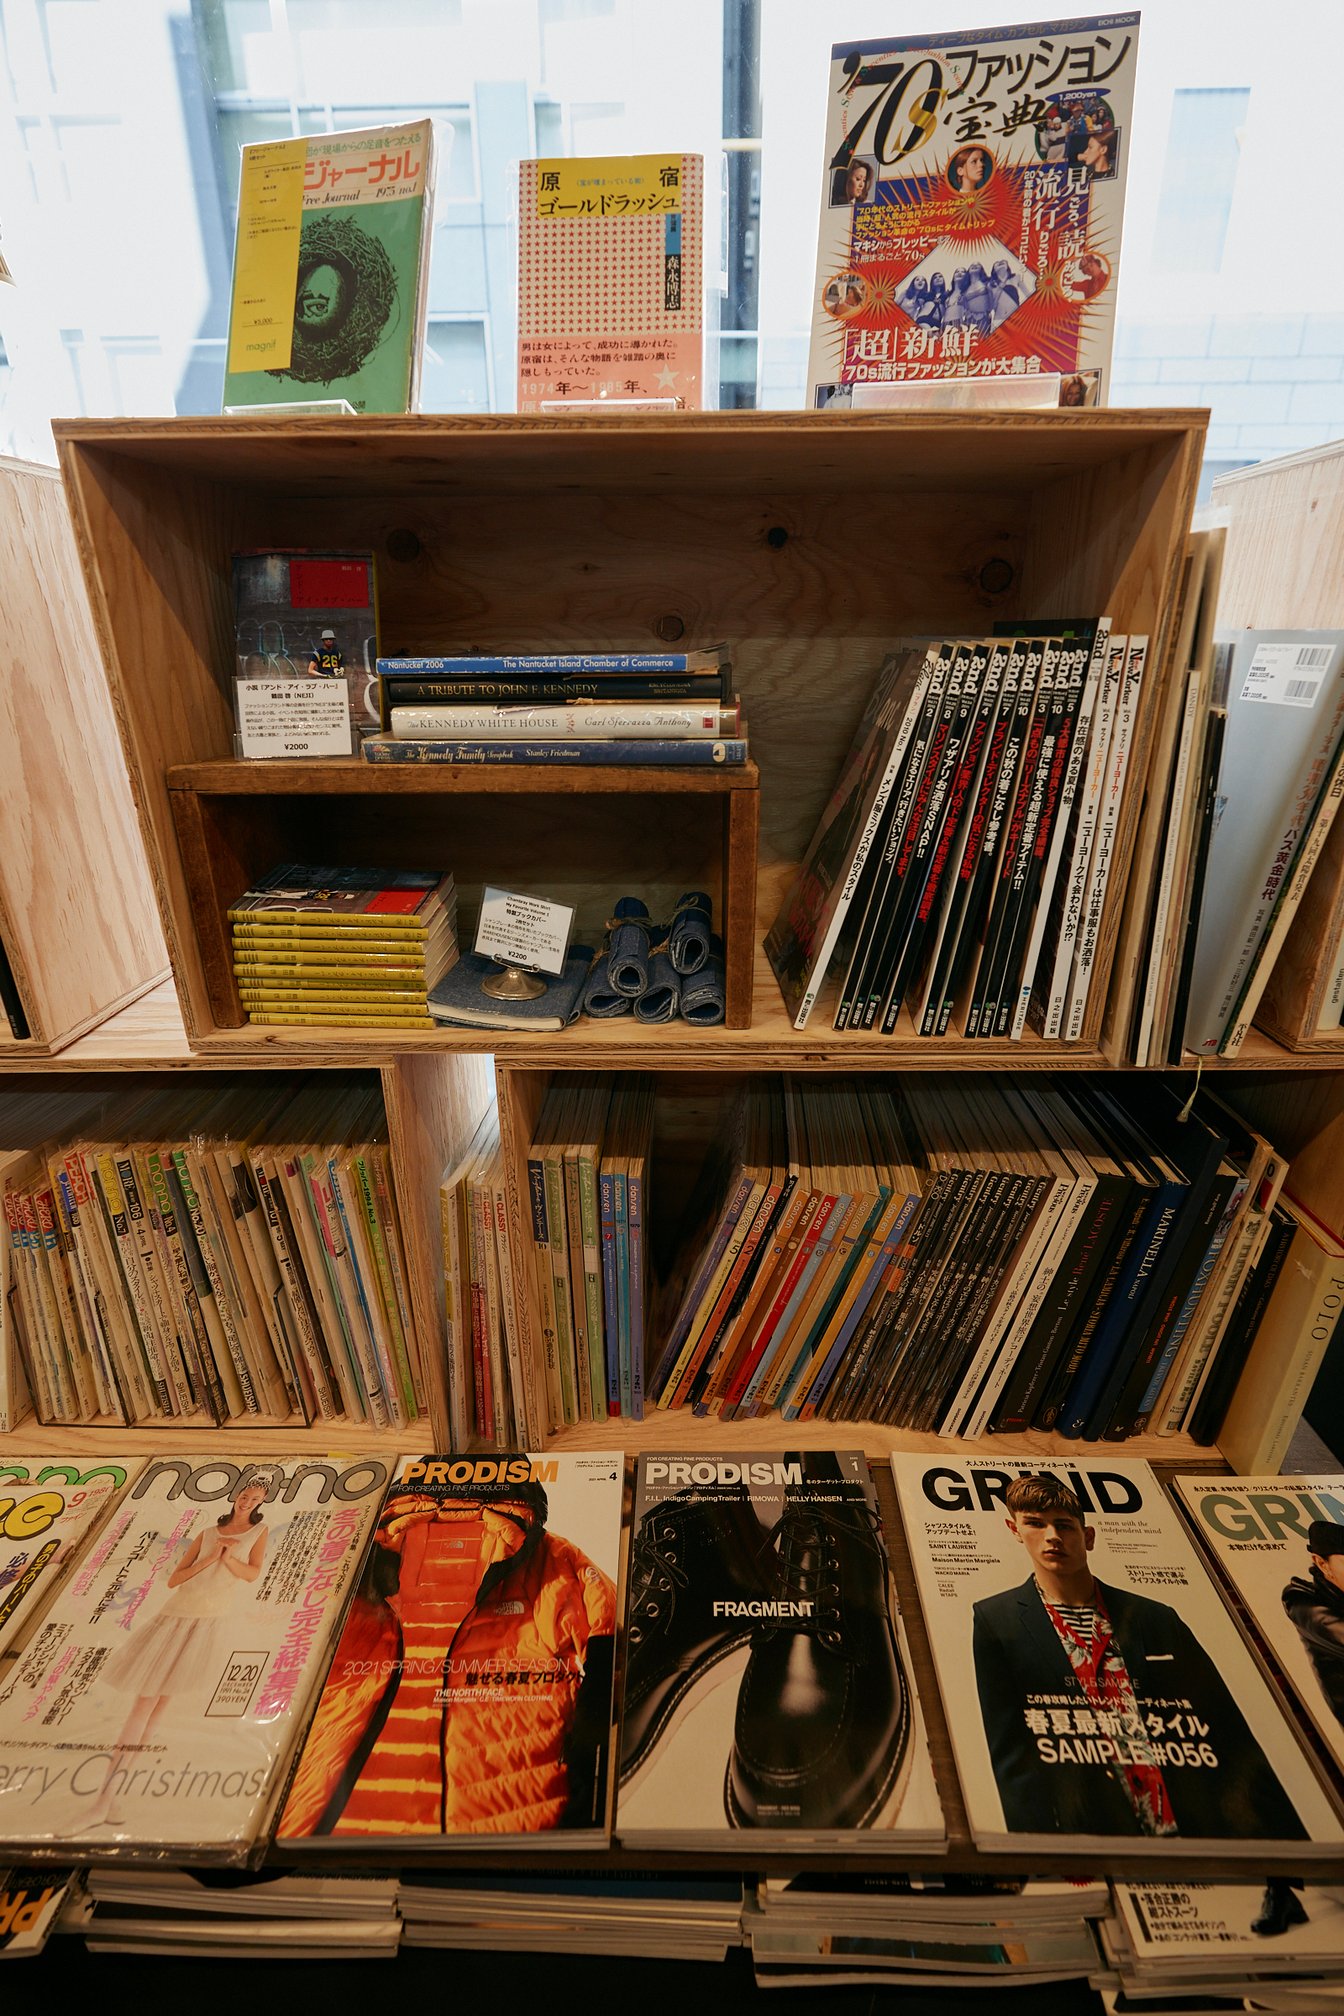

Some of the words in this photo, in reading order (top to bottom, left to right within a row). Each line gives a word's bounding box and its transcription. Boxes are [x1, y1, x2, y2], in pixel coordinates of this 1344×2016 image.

[946, 36, 1131, 100] ファッション
[540, 172, 560, 191] 原
[660, 167, 680, 187] 宿
[540, 194, 680, 216] ゴールドラッシュ
[522, 340, 678, 352] 男は女によって、成功に導かれた。
[1092, 629, 1108, 659] 2nd
[321, 655, 338, 668] 26
[388, 661, 424, 669] Nantucket
[425, 661, 444, 669] 2006
[503, 660, 517, 668] The
[518, 660, 557, 668] Nantucket
[559, 659, 582, 667] Island
[583, 659, 619, 667] Chamber
[621, 659, 630, 667] of
[631, 659, 673, 667] Commerce
[985, 653, 1008, 692] 2nd
[1004, 653, 1025, 692] 2nd
[1020, 653, 1042, 691] 2nd
[1040, 650, 1060, 689] 2nd
[1054, 651, 1075, 690] 2nd
[1069, 649, 1089, 687] 2nd
[928, 657, 951, 695] 2nd
[947, 657, 970, 695] 2nd
[963, 655, 986, 694] 2nd
[417, 685, 425, 695] A
[428, 685, 476, 695] TRIBUTE
[478, 685, 495, 695] TO
[498, 685, 528, 696] JOHN
[531, 685, 541, 694] F.
[543, 684, 598, 694] KENNEDY
[926, 709, 934, 717] 2
[944, 710, 952, 719] 8
[960, 709, 967, 718] 9
[981, 707, 989, 716] 4
[1002, 707, 1009, 716] 7
[1018, 707, 1028, 716] 10
[1038, 704, 1045, 713] 3
[1051, 705, 1063, 714] 10
[1067, 703, 1074, 712] 5
[1102, 714, 1108, 722] 2
[1123, 714, 1129, 723] 3
[420, 719, 476, 728] KENNEDY
[477, 719, 517, 728] WHITE
[519, 719, 558, 728] HOUSE
[584, 717, 605, 726] Carl
[653, 716, 691, 728] Anthony
[902, 717, 913, 735] 2010
[284, 743, 308, 751] ¥2000
[416, 747, 454, 762] Kennedy
[455, 747, 486, 762] Family
[1090, 751, 1103, 799] ニューヨーカー
[1110, 752, 1124, 800] ニューヨーカー
[841, 778, 893, 900] メンズ服ミックスが私のスタイル
[1261, 828, 1298, 901] バス黄金時代
[507, 950, 528, 960] ¥2200
[1015, 997, 1027, 1030] HERITAGE
[1201, 1038, 1217, 1047] JTB
[1231, 1023, 1248, 1047] 平凡社
[941, 1173, 958, 1200] Gentry
[954, 1174, 973, 1202] Gentry
[965, 1174, 984, 1201] Gentry
[979, 1176, 998, 1204] Gentry
[991, 1176, 1010, 1205] Gentry
[1003, 1180, 1022, 1209] Gentry
[1015, 1179, 1035, 1207] Gentry
[1027, 1182, 1047, 1211] Gentry
[130, 1203, 143, 1219] 106
[496, 1203, 506, 1233] CLASSY
[752, 1195, 776, 1233] dansen
[800, 1196, 818, 1226] dansen
[813, 1202, 832, 1230] dansen
[895, 1201, 914, 1230] dansen
[729, 1245, 738, 1255] 5
[744, 1246, 754, 1255] 2
[1058, 1299, 1069, 1310] Le
[1067, 1277, 1079, 1298] style
[1083, 1199, 1112, 1249] LACOSTE
[1137, 1207, 1176, 1278] MARINELLA
[1223, 1244, 1251, 1296] HENRY
[1128, 1280, 1140, 1300] NAPOLI
[1311, 1277, 1343, 1342] POLO
[1082, 1310, 1101, 1337] STORIA
[1200, 1302, 1228, 1353] POOLE
[1075, 1335, 1091, 1354] MITO
[1066, 1355, 1082, 1373] MODA
[401, 1461, 559, 1485] PRODISM
[609, 1472, 618, 1481] 4
[645, 1463, 803, 1485] PRODISM
[851, 1461, 859, 1471] 1
[67, 1492, 87, 1509] 9
[397, 1485, 412, 1493] FOR
[469, 1484, 510, 1492] PRODUCTS
[663, 1495, 686, 1503] Indigo
[1101, 1527, 1142, 1535] independent
[253, 1508, 361, 1716] 冬の着こなし完全総集編
[713, 1601, 815, 1618] FRAGMENT
[71, 1647, 96, 1677] スタイル
[343, 1662, 379, 1676] 2021
[380, 1659, 507, 1674] SPRING/SUMMER
[509, 1658, 571, 1672] SEASON
[465, 1672, 585, 1685] 魅せる春夏プロダクト
[434, 1689, 451, 1697] THE
[452, 1689, 481, 1697] NORTH
[482, 1688, 503, 1696] FACE
[1024, 1708, 1210, 1737] 春夏最新スタイル
[70, 1753, 280, 1799] Christmas!
